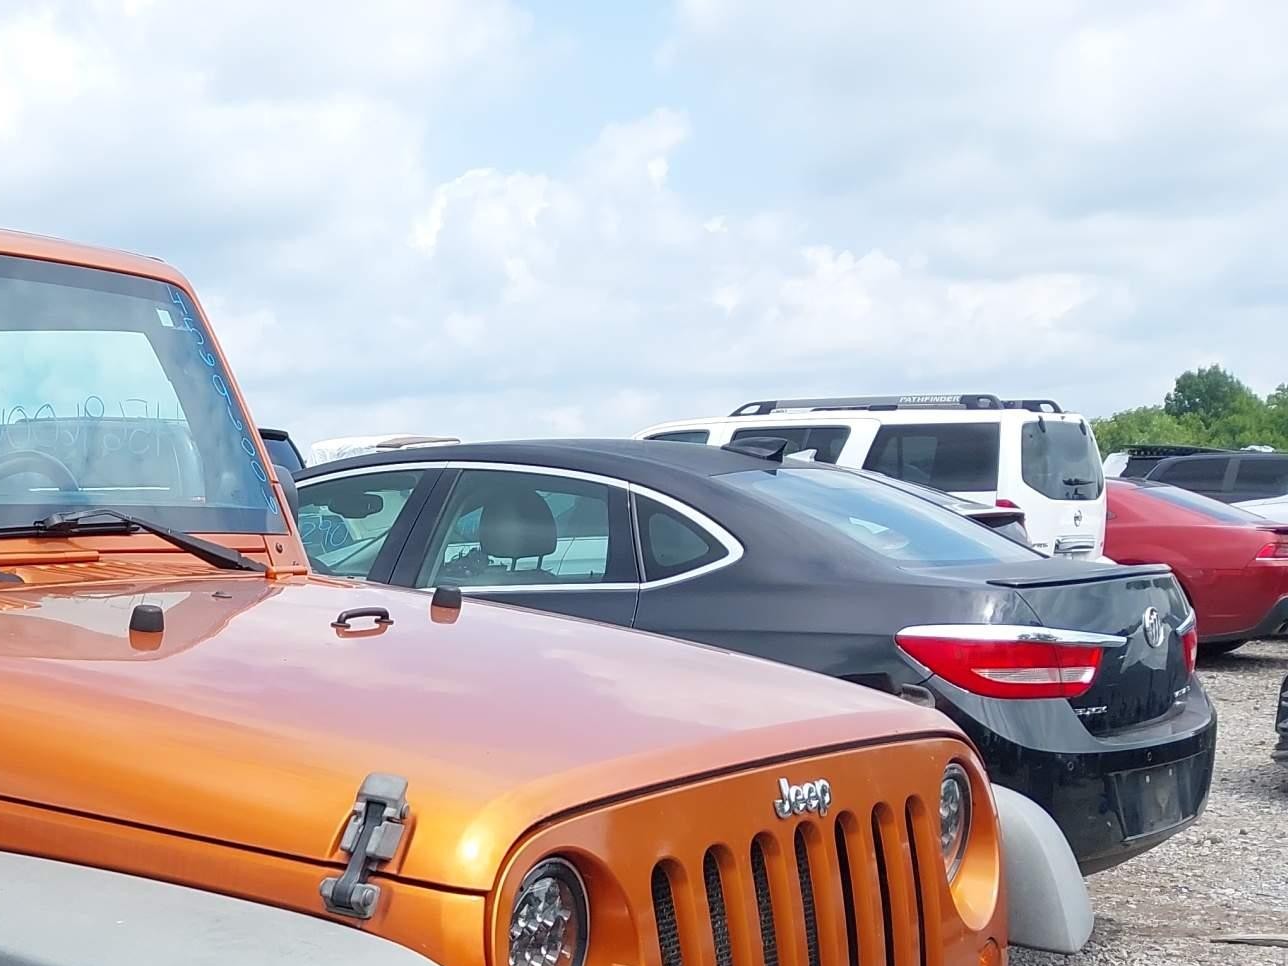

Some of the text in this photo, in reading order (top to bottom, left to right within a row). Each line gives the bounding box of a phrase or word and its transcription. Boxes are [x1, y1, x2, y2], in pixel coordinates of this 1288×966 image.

[167, 285, 278, 514] 45696006
[899, 395, 961, 403] PATHFINDER
[773, 777, 832, 819] Jeep
